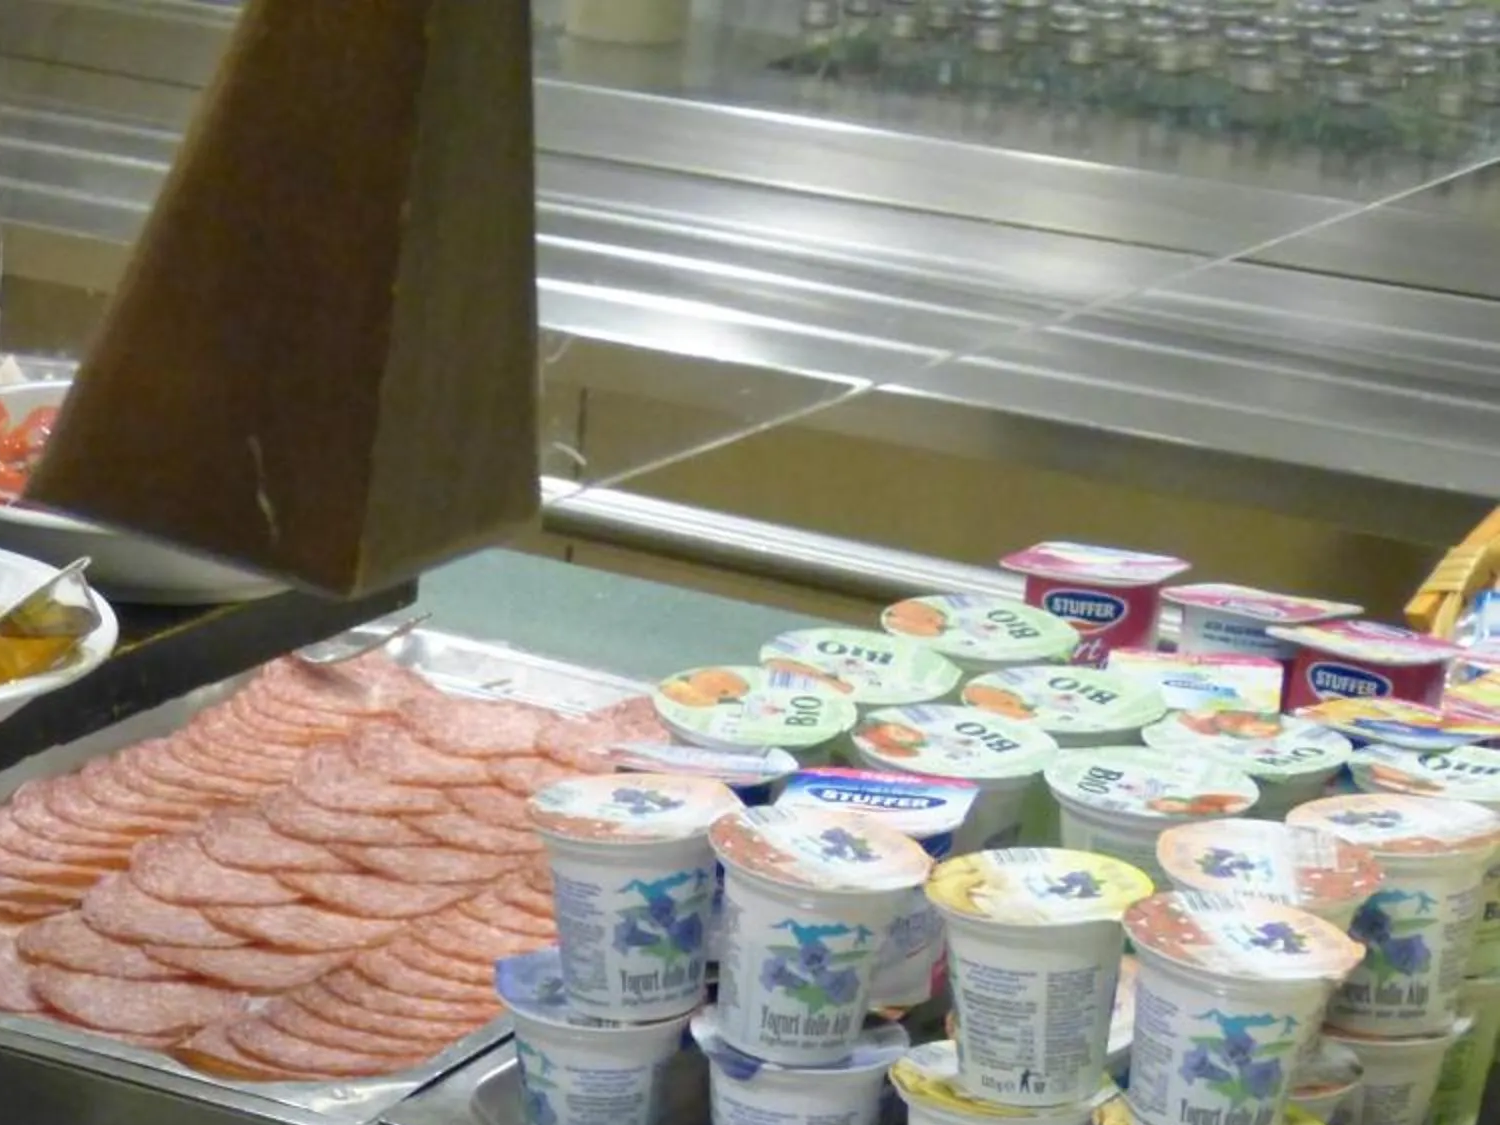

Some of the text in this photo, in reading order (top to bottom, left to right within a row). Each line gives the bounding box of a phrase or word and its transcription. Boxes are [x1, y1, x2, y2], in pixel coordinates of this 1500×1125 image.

[1052, 597, 1116, 618] STUFFER
[986, 609, 1041, 639] BIO
[1048, 676, 1120, 705] BIO
[1314, 669, 1378, 695] STUFFER
[785, 696, 823, 726] BIO
[954, 721, 1022, 753] BIO
[1077, 766, 1125, 794] BIO
[820, 788, 932, 809] STUFFER
[761, 1004, 800, 1041] Yogurt
